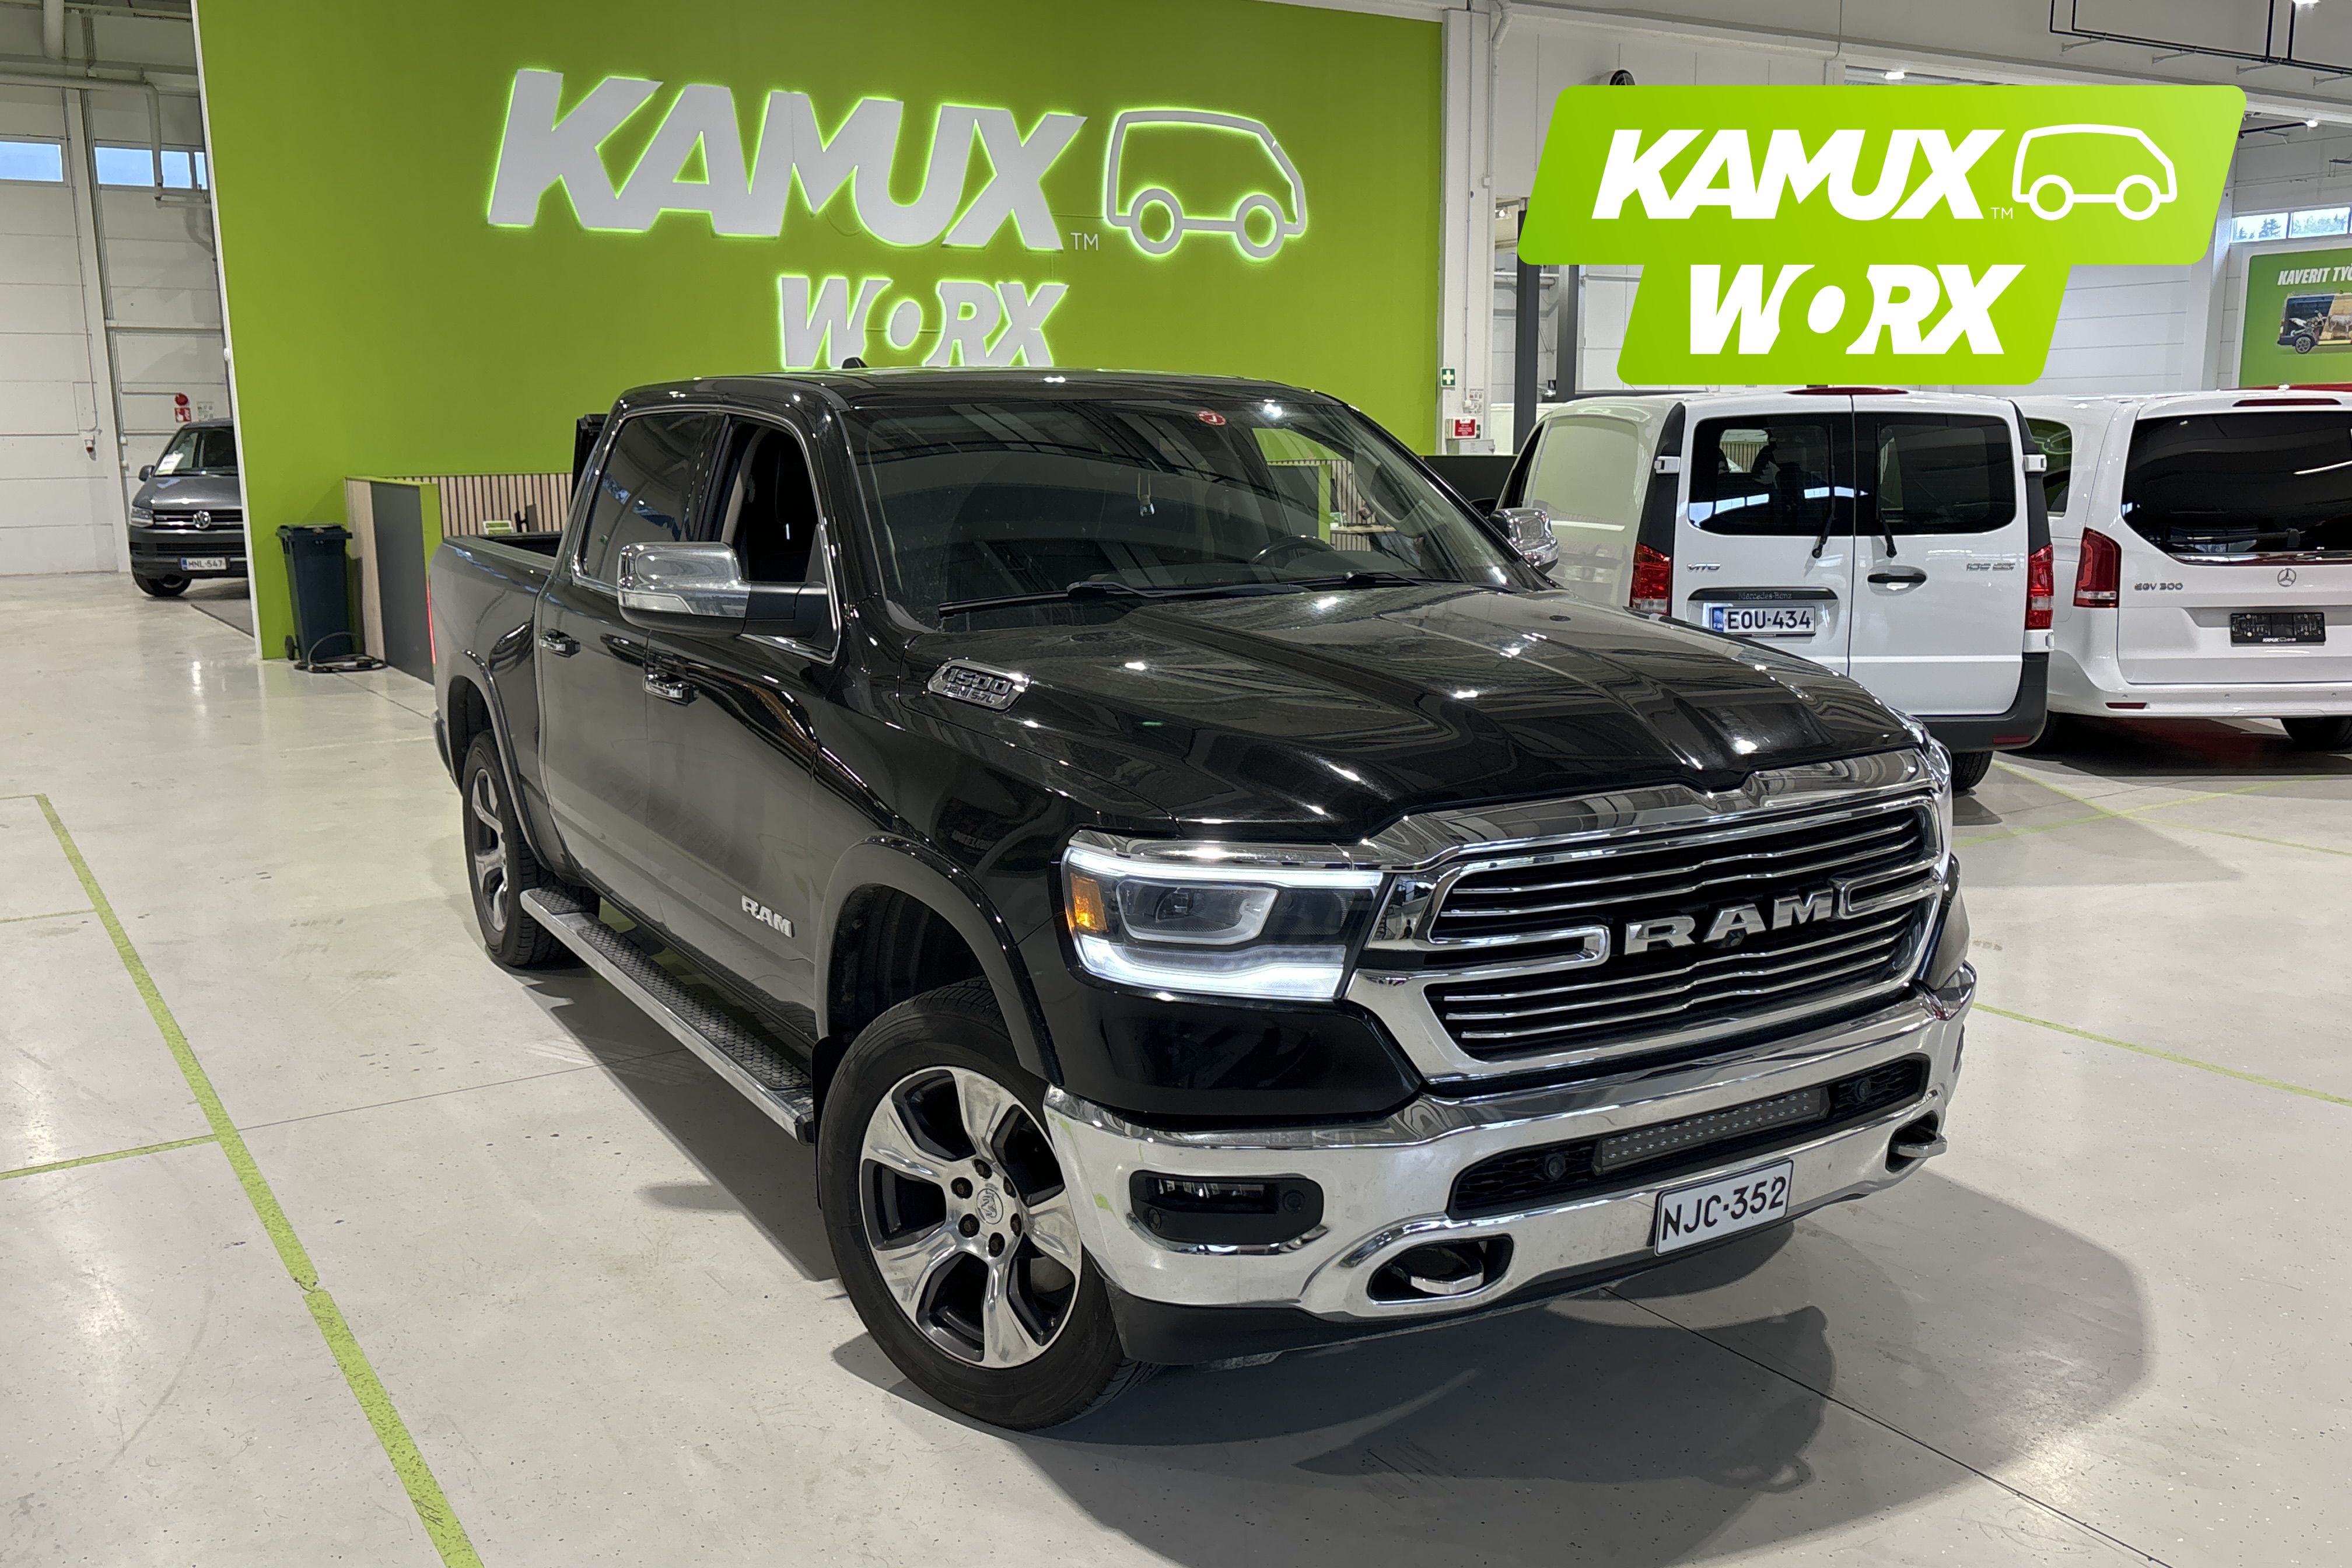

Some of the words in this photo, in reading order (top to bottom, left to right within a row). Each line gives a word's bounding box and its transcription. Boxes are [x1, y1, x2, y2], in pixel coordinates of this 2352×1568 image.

[487, 68, 1087, 252] KAMUX
[2277, 267, 2331, 286] KAVERIT
[778, 275, 1070, 370] WORX
[1738, 592, 1792, 600] Mercedes-Benz
[1727, 610, 1811, 629] EOU-434
[942, 684, 970, 698] HEMI
[946, 668, 1013, 695] 1500
[741, 895, 794, 938] RAM
[1625, 889, 1833, 955] RAM
[1662, 1176, 1786, 1241] NJC-352
